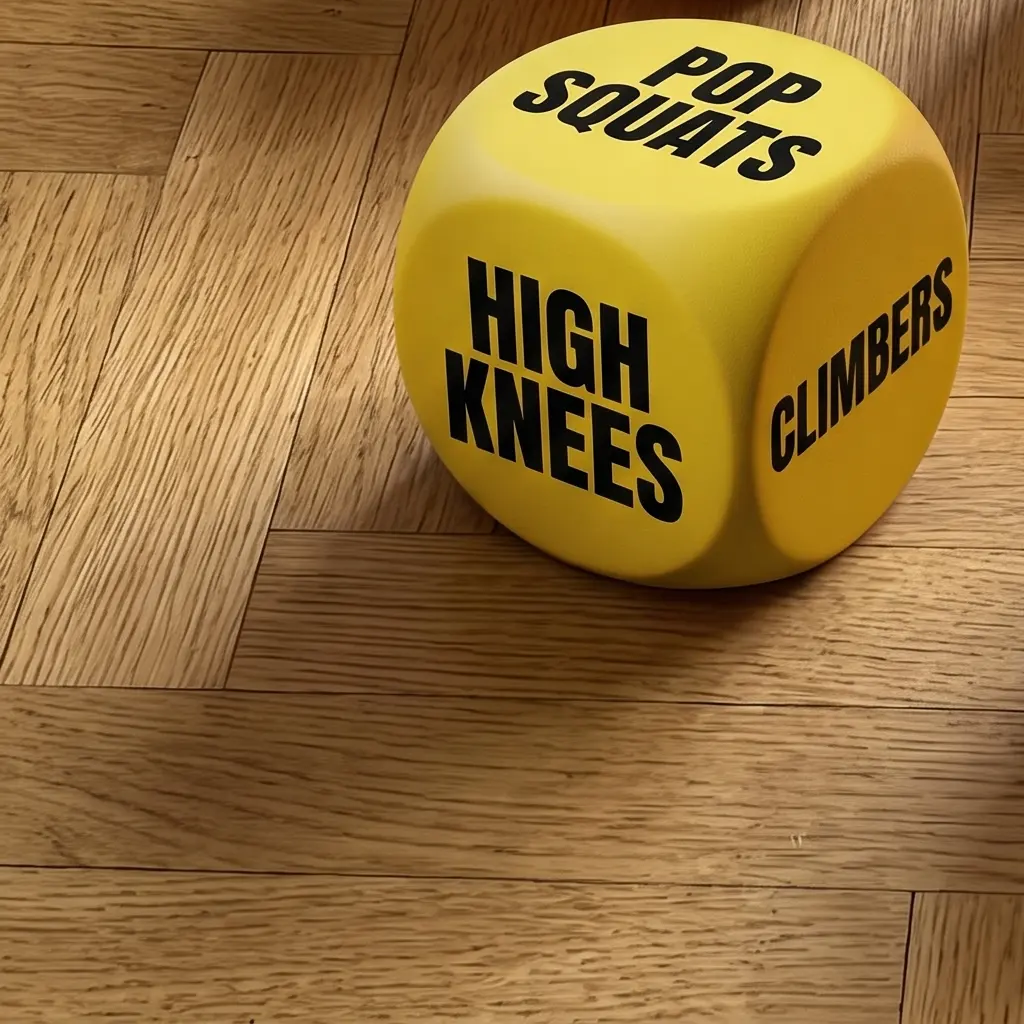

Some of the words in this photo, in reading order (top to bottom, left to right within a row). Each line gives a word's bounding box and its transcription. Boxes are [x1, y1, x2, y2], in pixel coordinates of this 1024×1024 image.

[513, 70, 822, 181] SQUATS
[640, 45, 823, 115] POP
[467, 255, 651, 413] HIGH
[771, 257, 953, 473] CLIMBERS
[444, 348, 684, 524] KNEES
